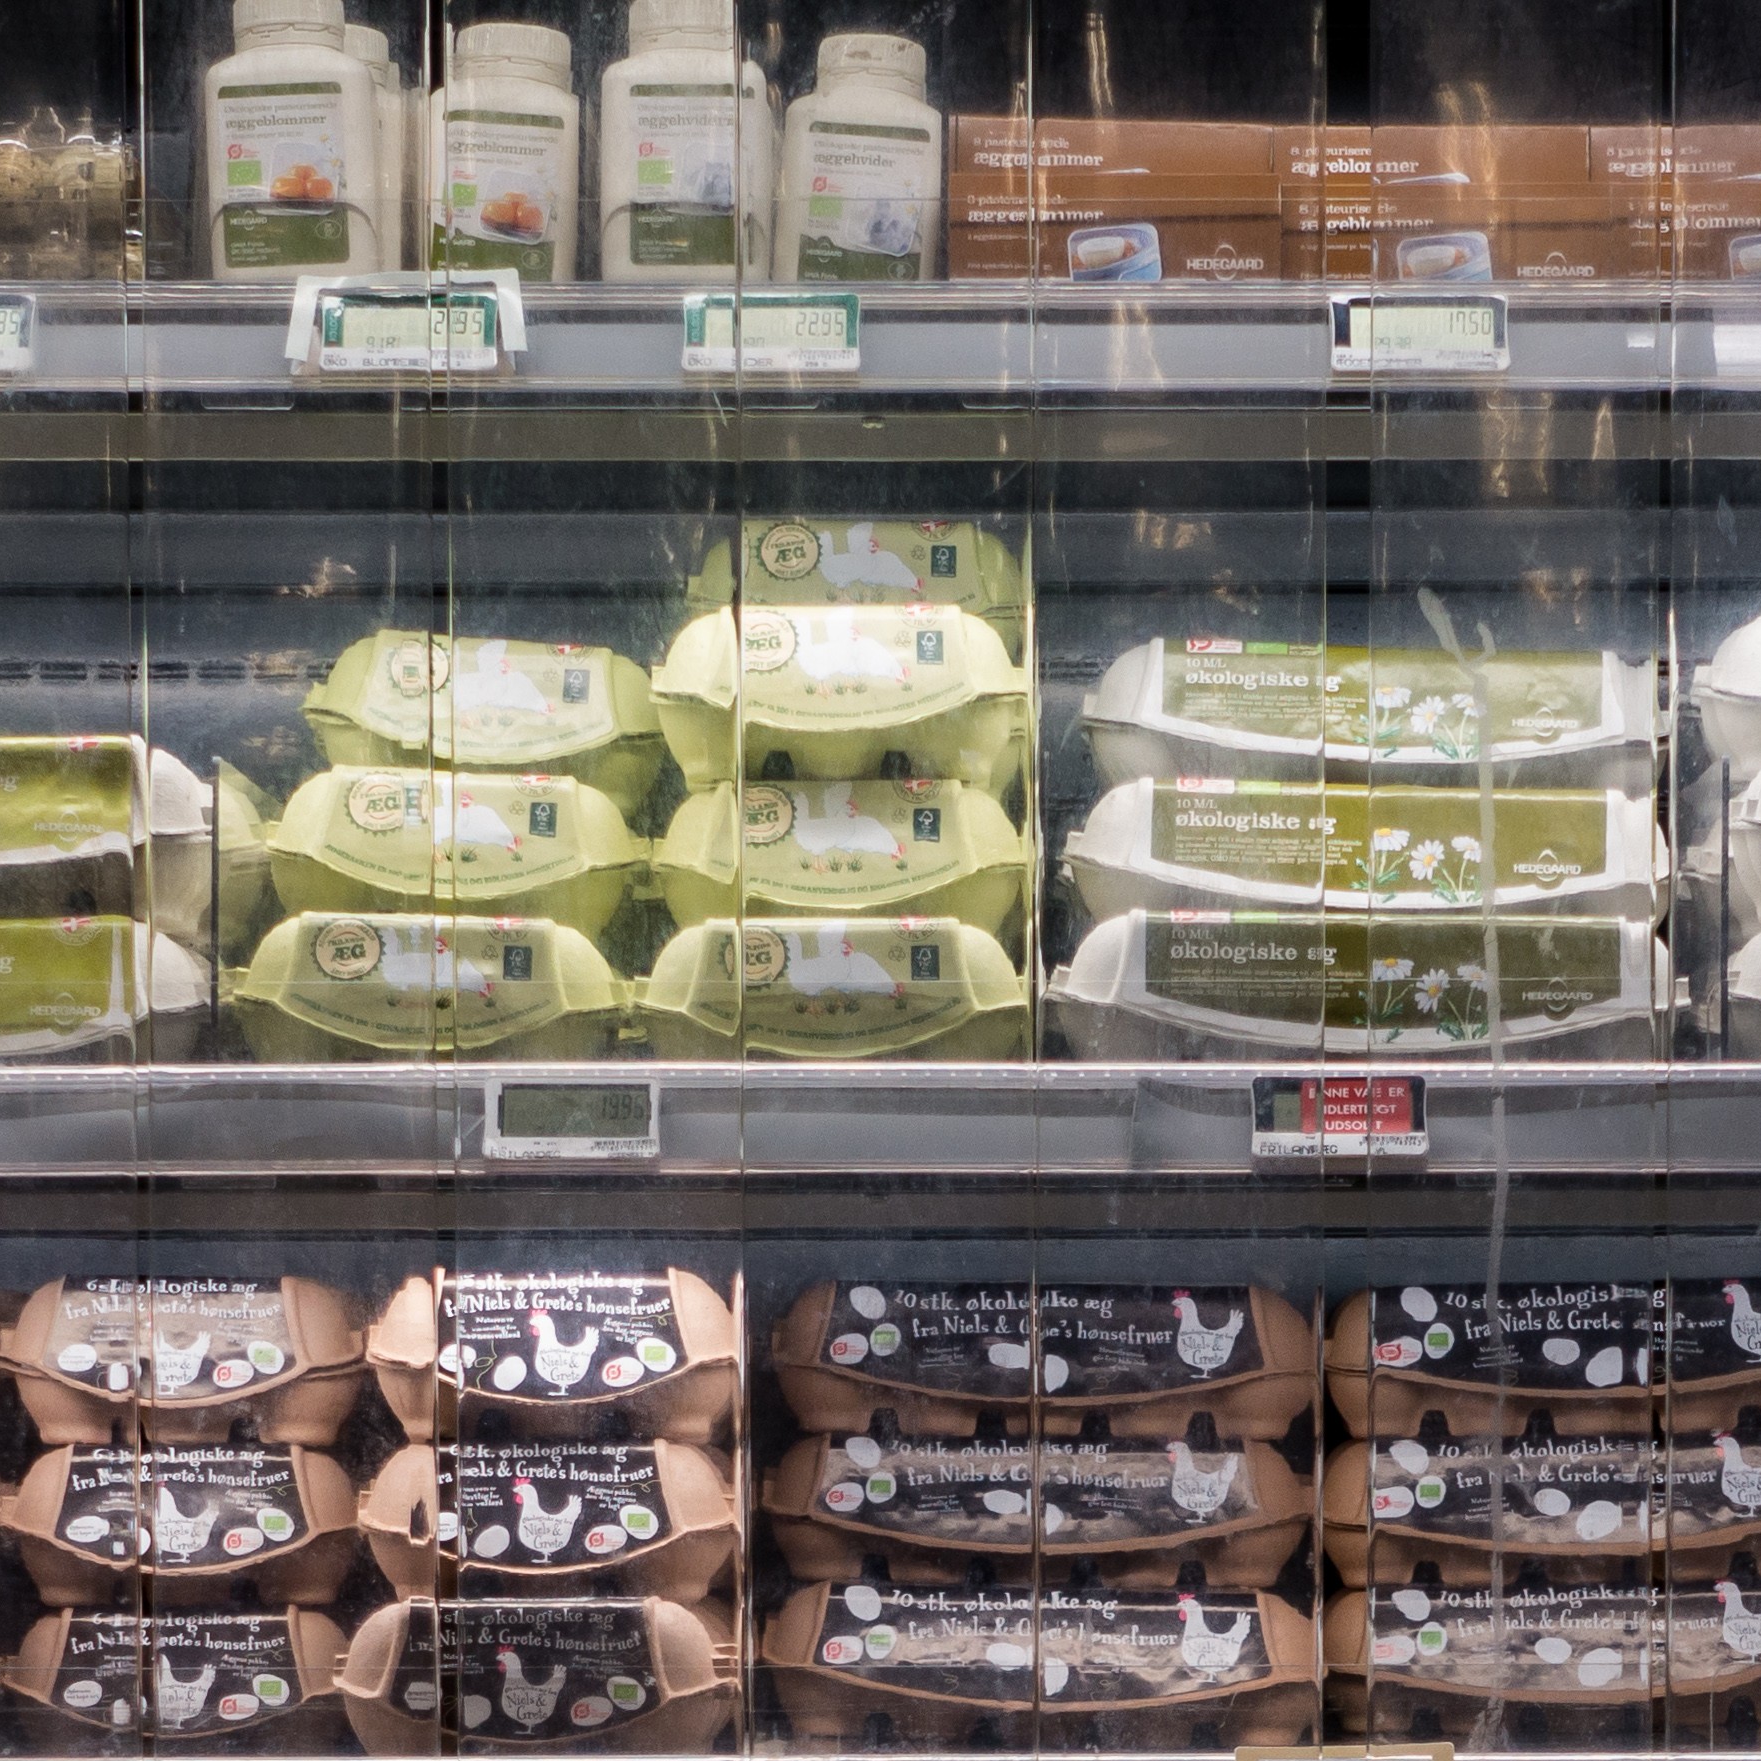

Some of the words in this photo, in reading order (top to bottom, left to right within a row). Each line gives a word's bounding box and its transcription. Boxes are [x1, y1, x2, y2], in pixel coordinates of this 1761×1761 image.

[226, 114, 326, 132] æggeblommer
[813, 152, 896, 169] æggehvider
[1517, 266, 1595, 278] HEDEGAARD
[773, 545, 806, 563] ÆG
[1186, 657, 1202, 668] 10
[1206, 657, 1227, 668] M/L
[1185, 669, 1309, 691] økologiske
[1174, 811, 1302, 832] økologiske
[1513, 864, 1581, 874] HEDEGAARD
[334, 943, 366, 961] ÆG
[514, 1292, 529, 1310] &
[532, 1292, 583, 1312] Grete's
[586, 1296, 671, 1315] hønsefruer
[920, 1291, 960, 1311] stk.
[913, 1318, 939, 1338] fra
[943, 1315, 984, 1334] Niels
[995, 1316, 1012, 1334] &
[1077, 1321, 1173, 1344] hønsefruer
[1465, 1318, 1491, 1339] fra
[1497, 1313, 1540, 1333] Niels
[1547, 1313, 1563, 1330] &
[917, 1440, 957, 1457] stk.
[206, 1471, 289, 1489] hønsefruer
[516, 1461, 567, 1479] Grete's
[569, 1463, 654, 1483] hønsefruer
[908, 1467, 935, 1487] fra
[940, 1465, 984, 1484] Niels
[1071, 1467, 1169, 1488] hønsefruer
[918, 1592, 958, 1612] stk.
